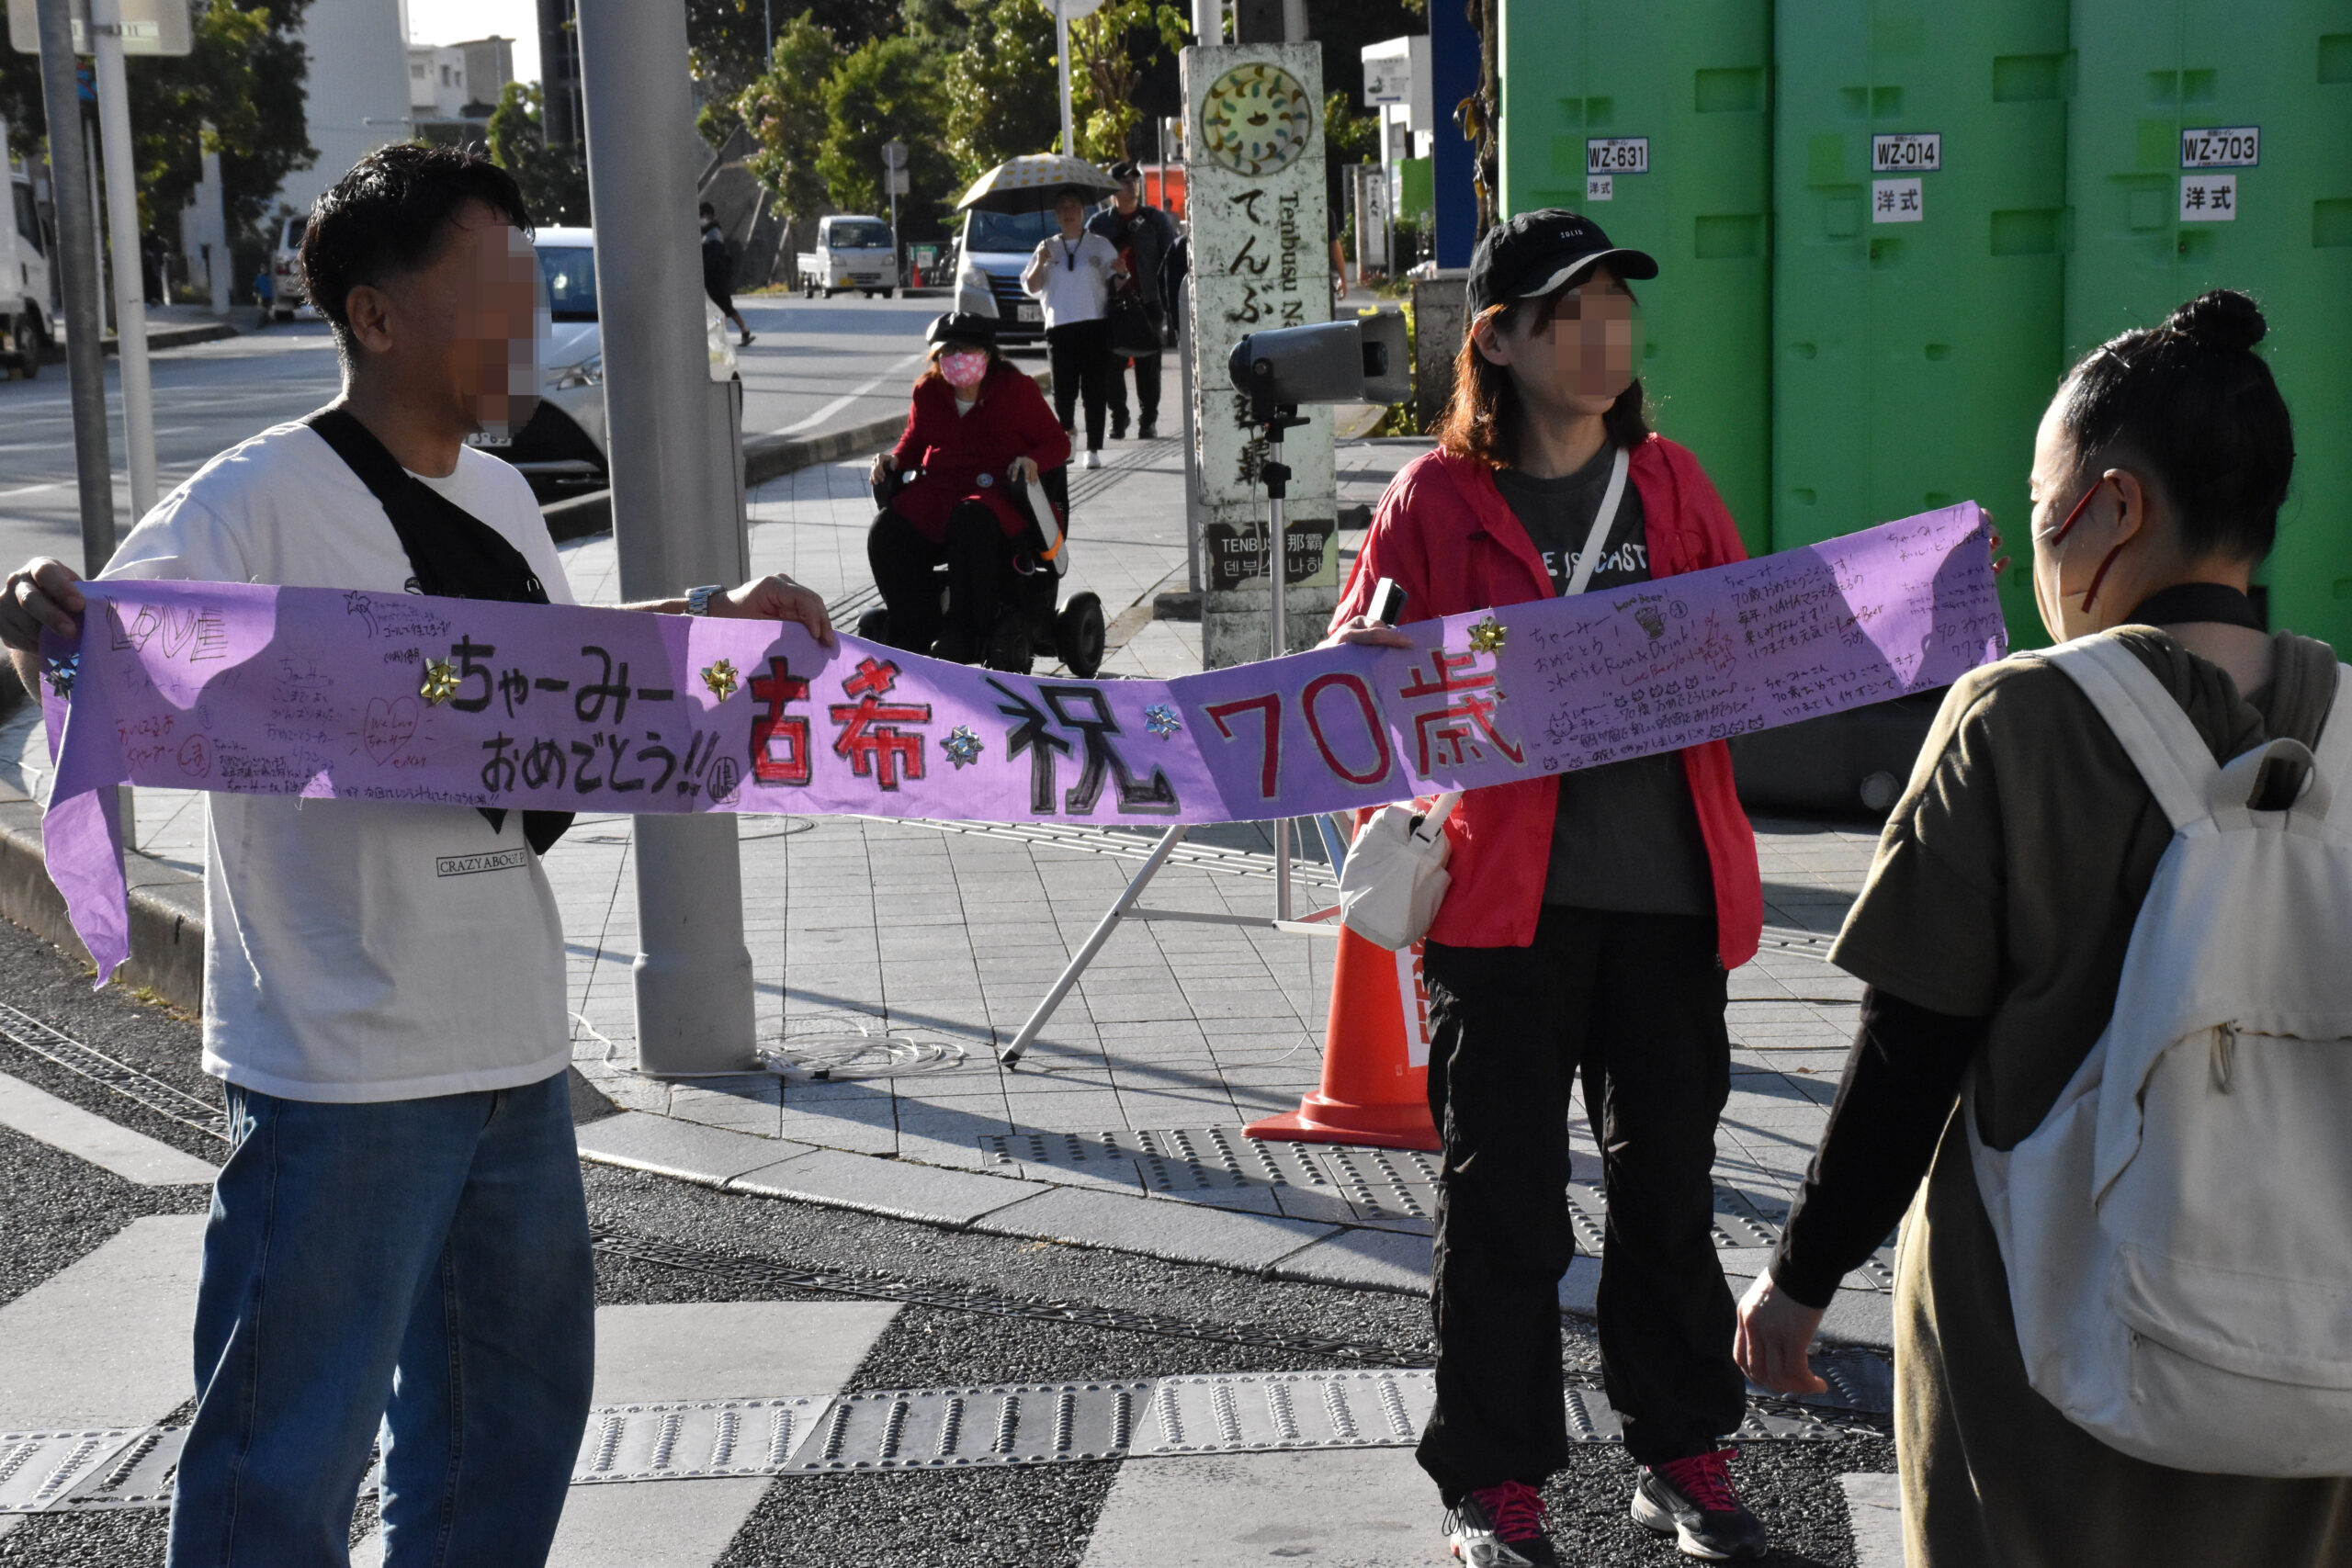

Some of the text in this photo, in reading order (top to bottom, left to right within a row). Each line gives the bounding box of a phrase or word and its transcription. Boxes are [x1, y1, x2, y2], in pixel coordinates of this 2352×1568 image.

[1589, 181, 1611, 195] 洋式
[1877, 188, 1918, 212] 洋式
[2186, 186, 2232, 210] 洋式
[1278, 191, 1300, 292] Tenbusu
[105, 594, 229, 663] LOVE
[449, 634, 674, 725] ちゃーみー
[747, 647, 1528, 817] 古希 祝 70歳
[440, 858, 482, 874] CRAZY
